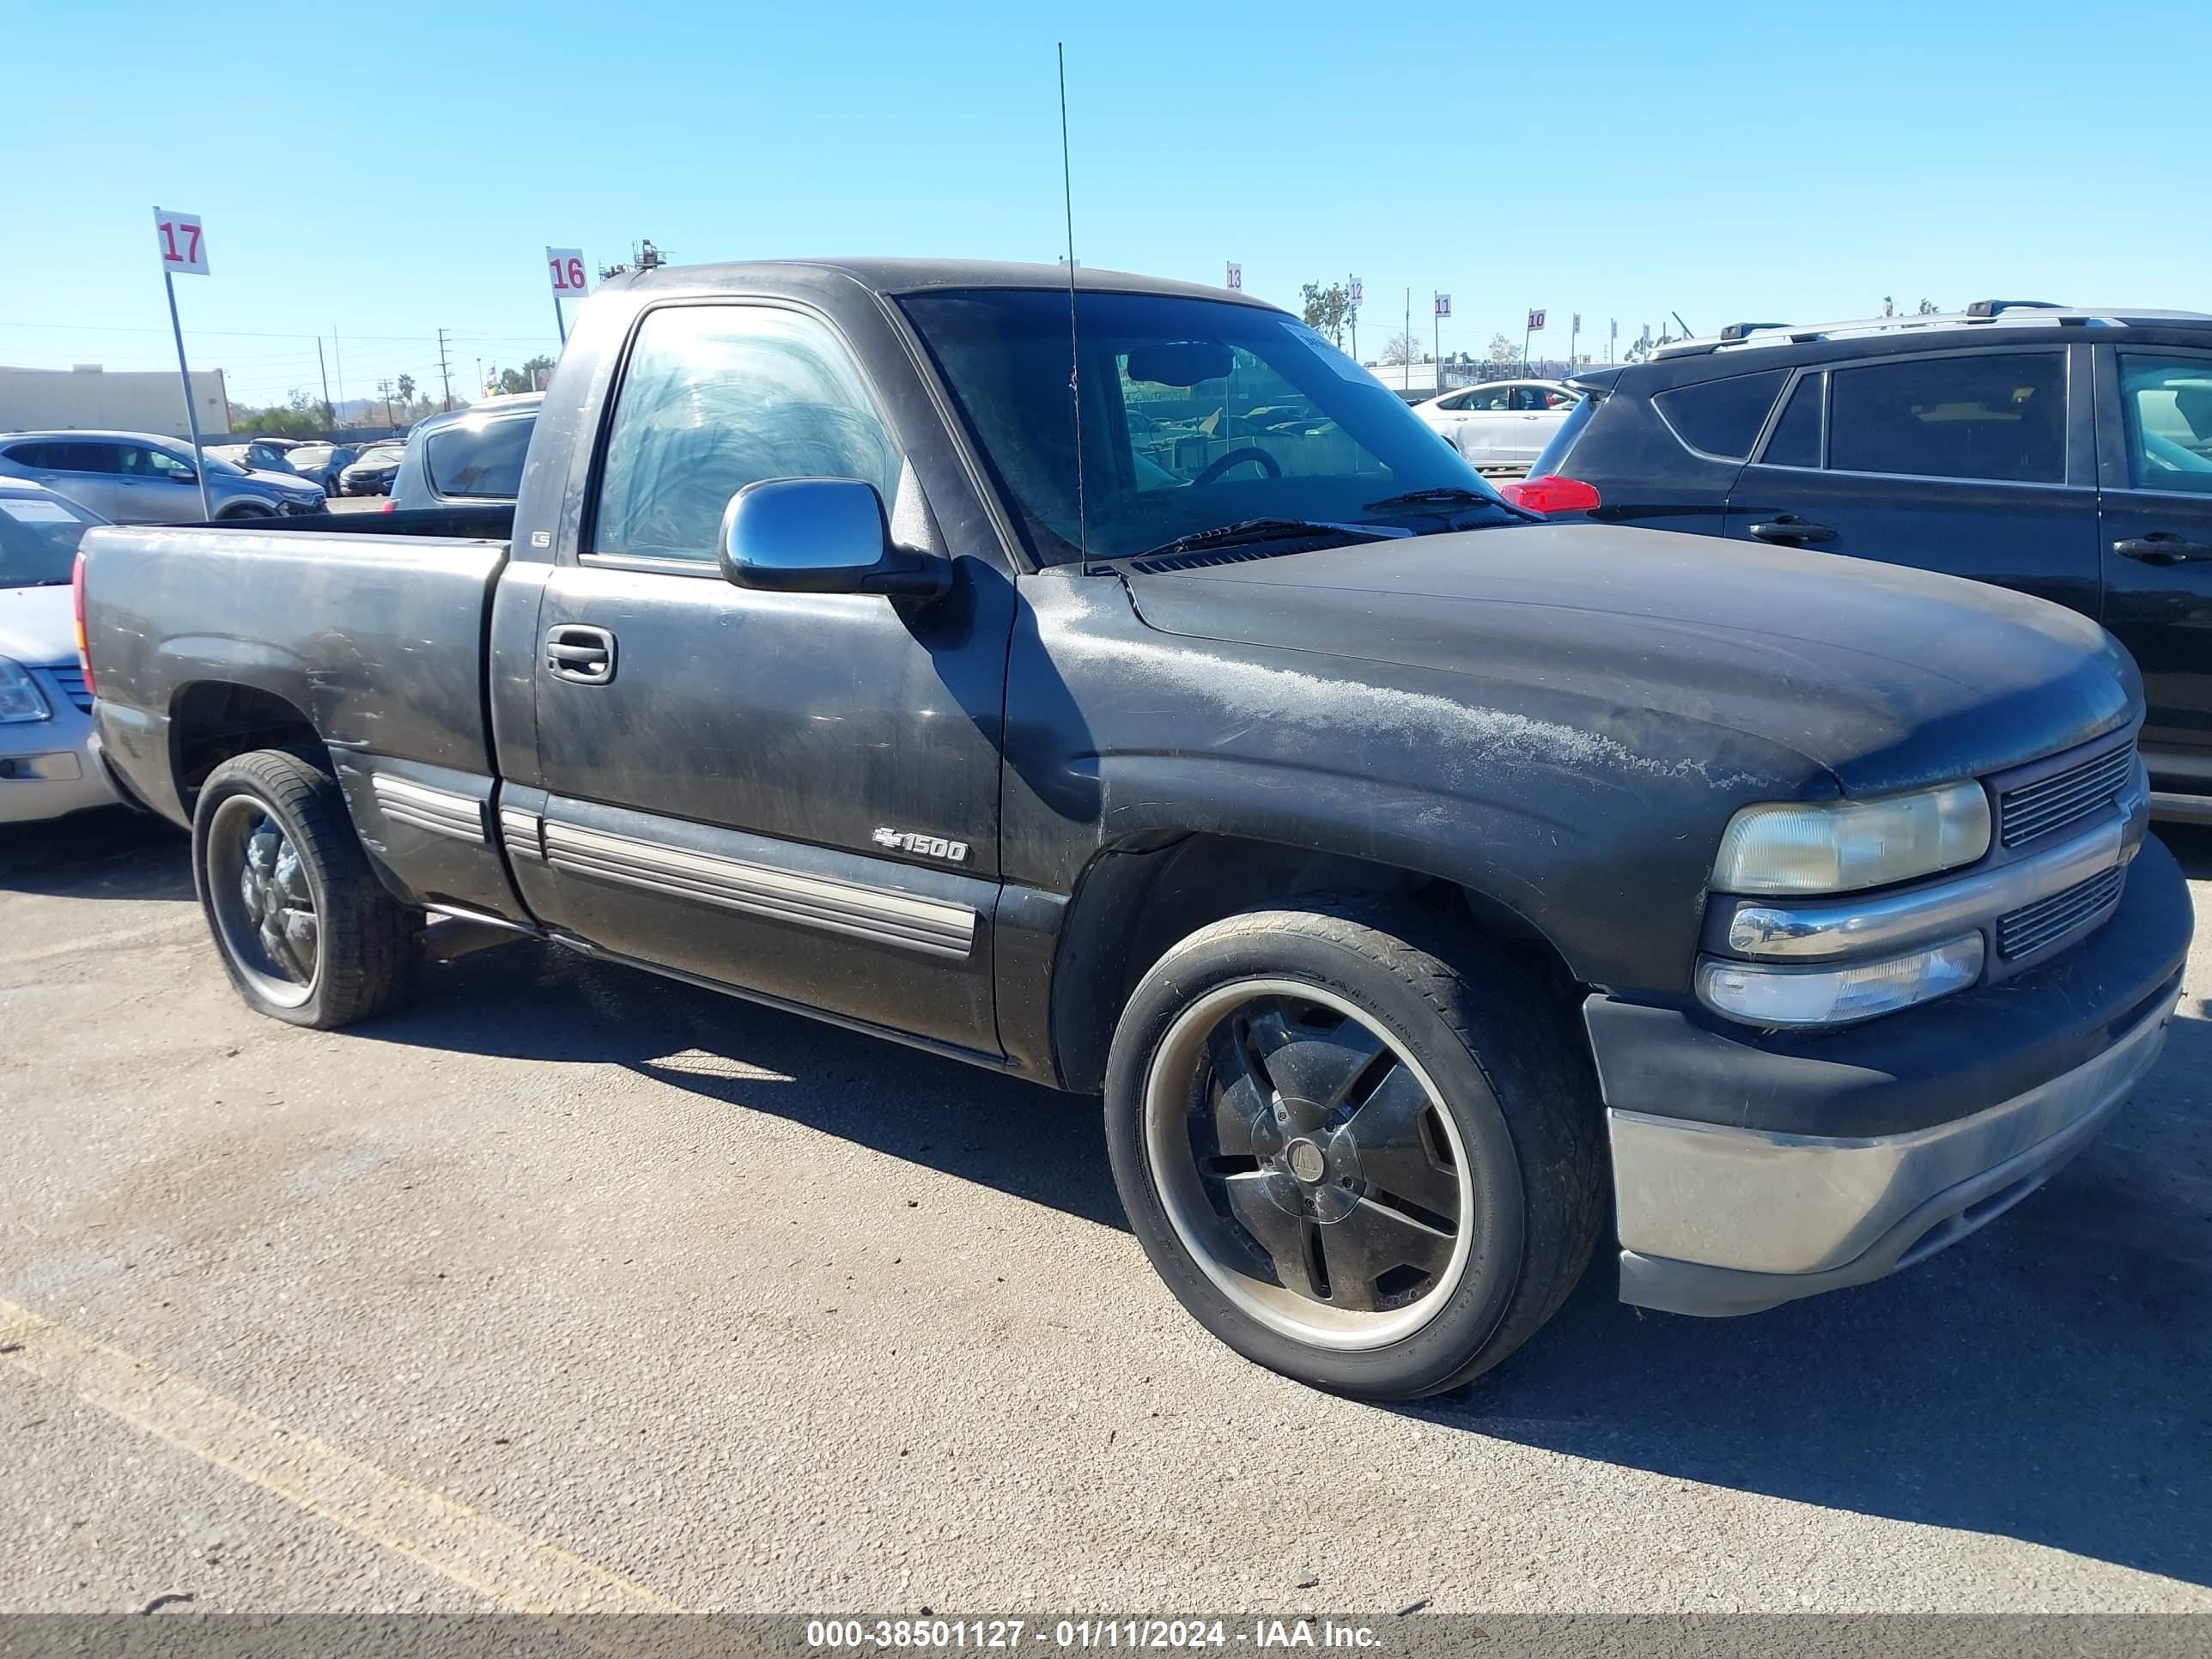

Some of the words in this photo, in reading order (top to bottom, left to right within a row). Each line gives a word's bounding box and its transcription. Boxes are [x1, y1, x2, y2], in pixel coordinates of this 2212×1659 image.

[159, 222, 201, 264] 17
[550, 258, 586, 289] 16
[1228, 268, 1242, 289] 13
[1350, 283, 1363, 301] 12
[1435, 298, 1450, 314] 11
[1528, 313, 1546, 329] 10
[531, 531, 551, 549] LS
[902, 832, 969, 861] 1500
